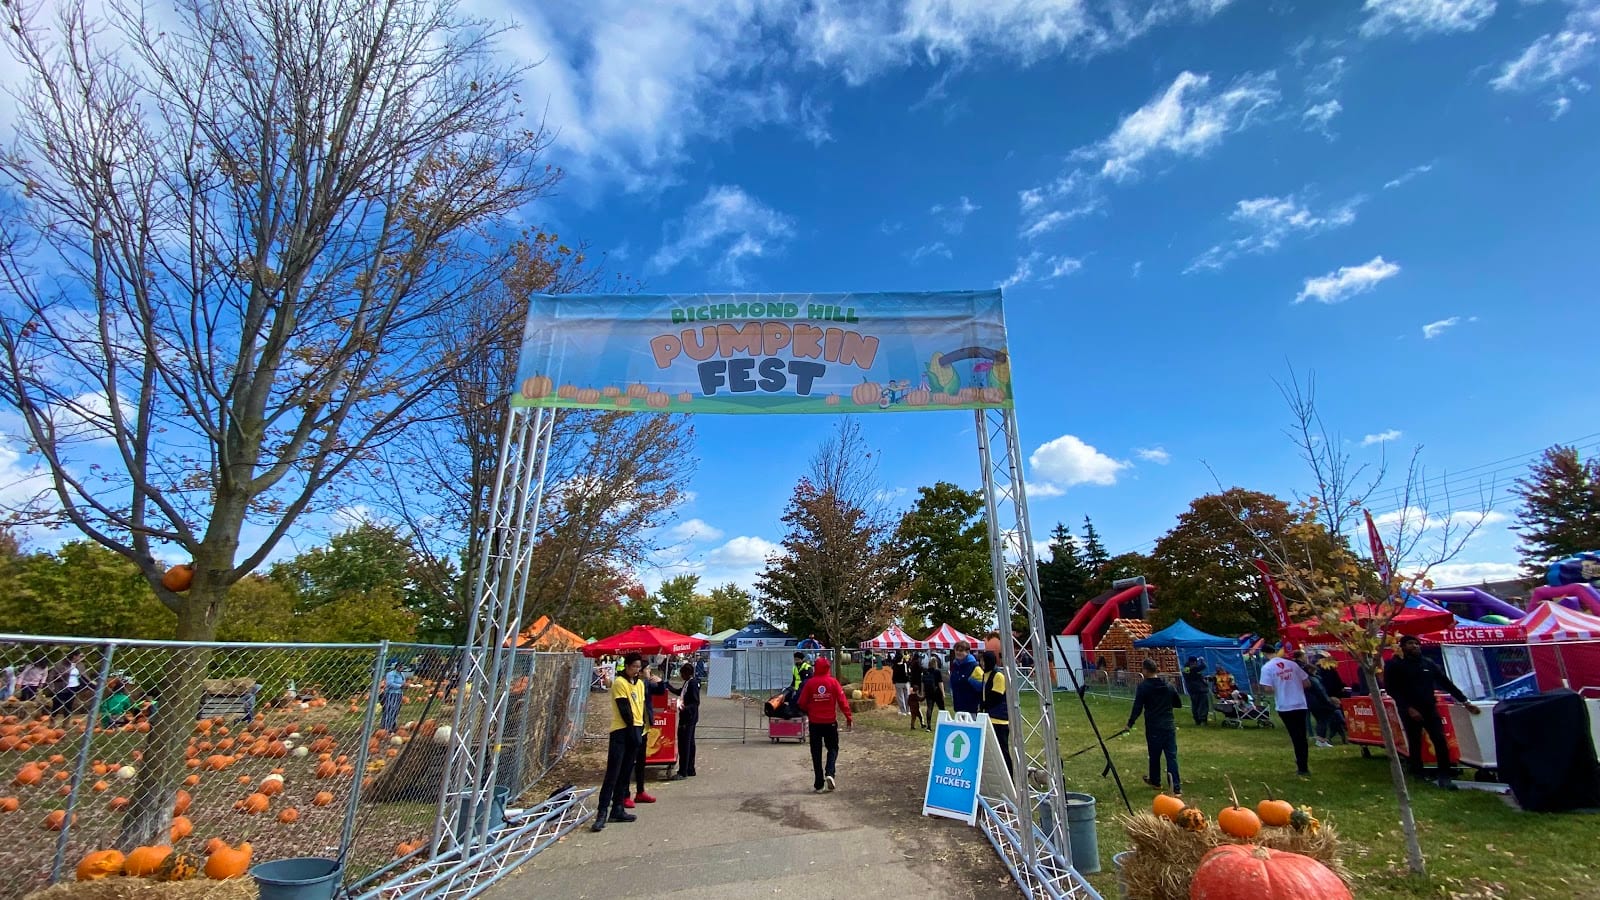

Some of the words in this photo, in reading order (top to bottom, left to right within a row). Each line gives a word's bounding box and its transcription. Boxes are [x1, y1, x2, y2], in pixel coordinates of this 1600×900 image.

[671, 302, 799, 324] RICHMOND
[807, 304, 859, 324] HILL
[650, 321, 879, 370] PUMPKIN
[698, 357, 826, 397] FEST
[1440, 629, 1505, 640] TICKETS
[945, 766, 964, 776] BUY
[935, 775, 971, 789] TICKETS
